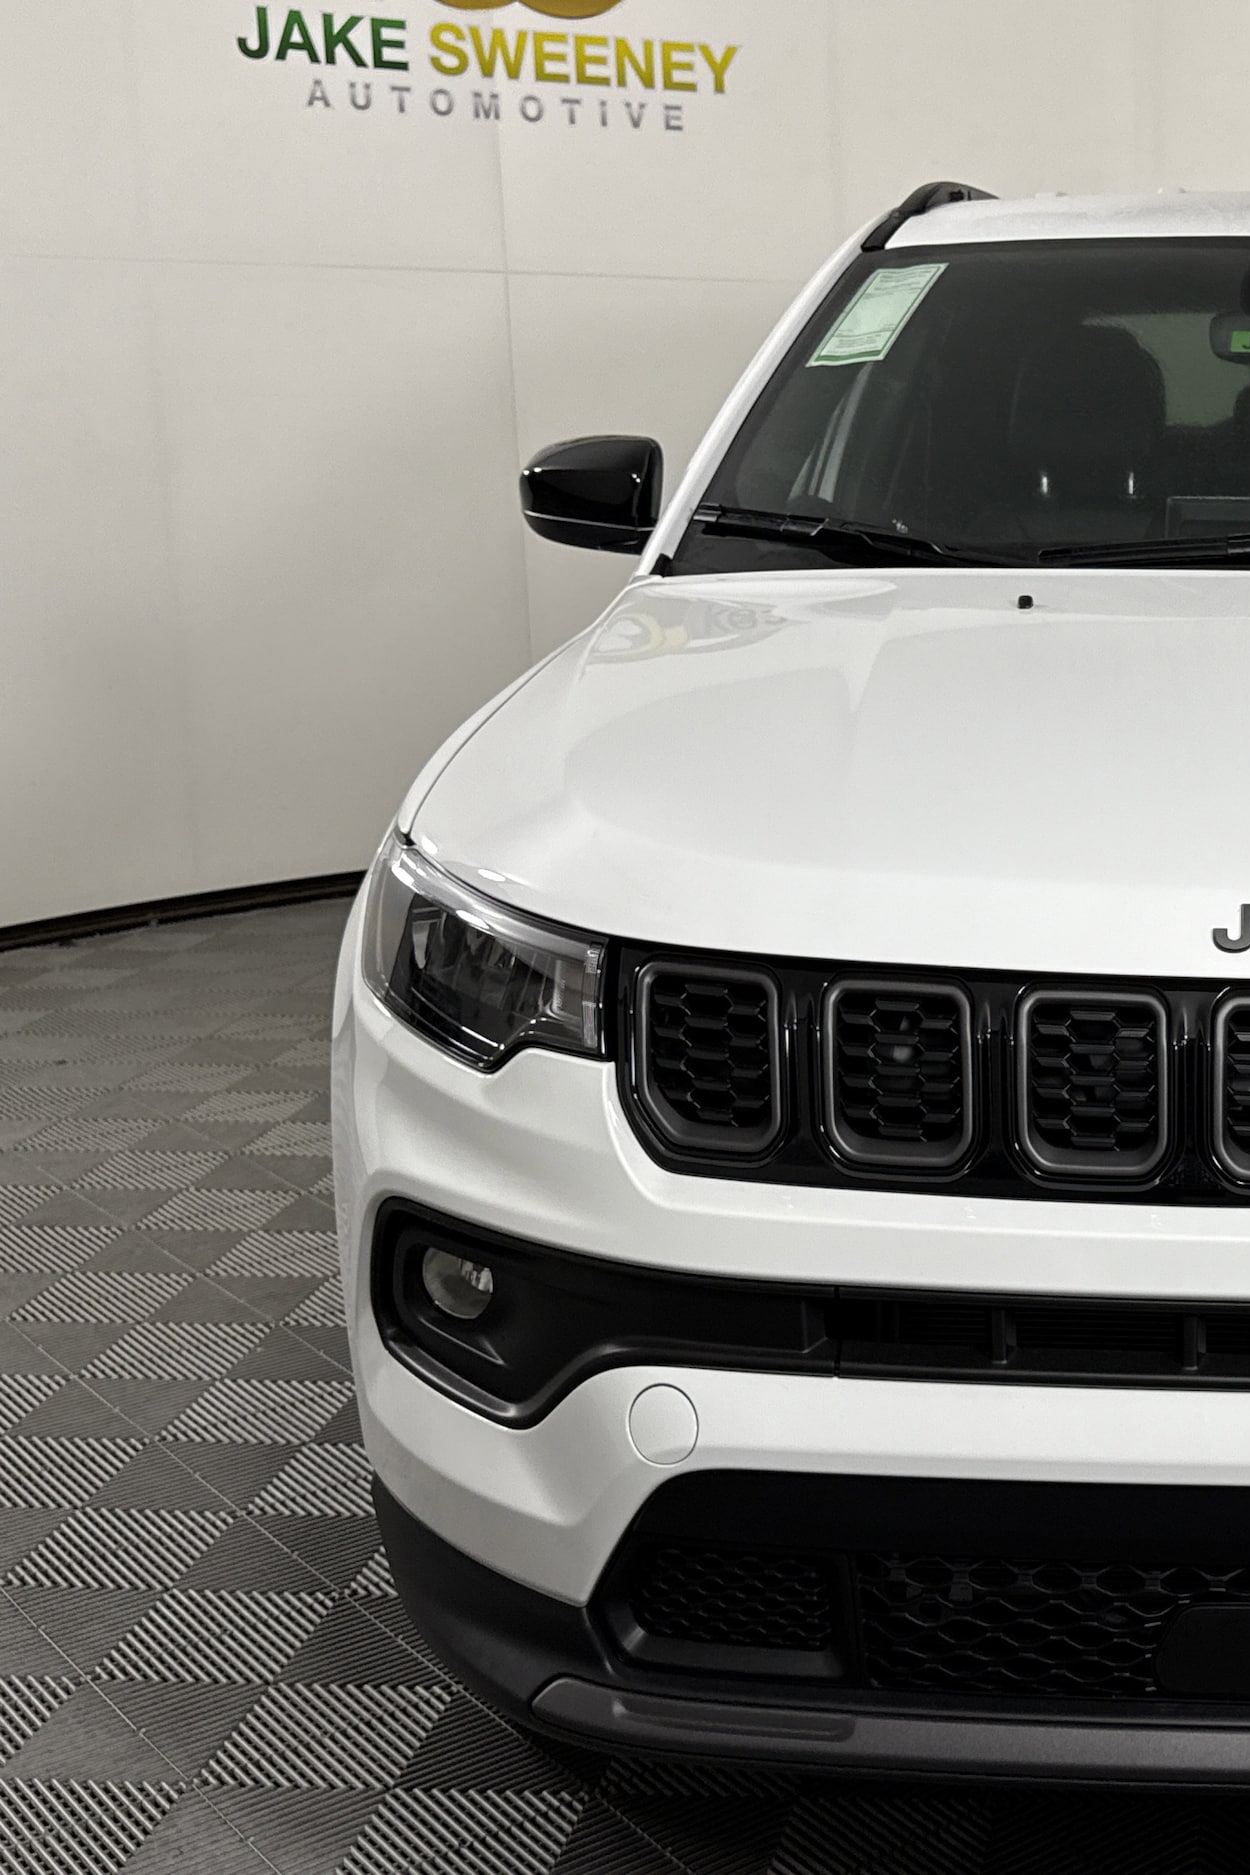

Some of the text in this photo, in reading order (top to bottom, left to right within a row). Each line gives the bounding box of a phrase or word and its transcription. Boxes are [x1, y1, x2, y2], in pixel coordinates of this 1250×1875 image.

[237, 5, 738, 94] JAKE SWEENEY
[307, 79, 684, 131] AUTOMOTIVE
